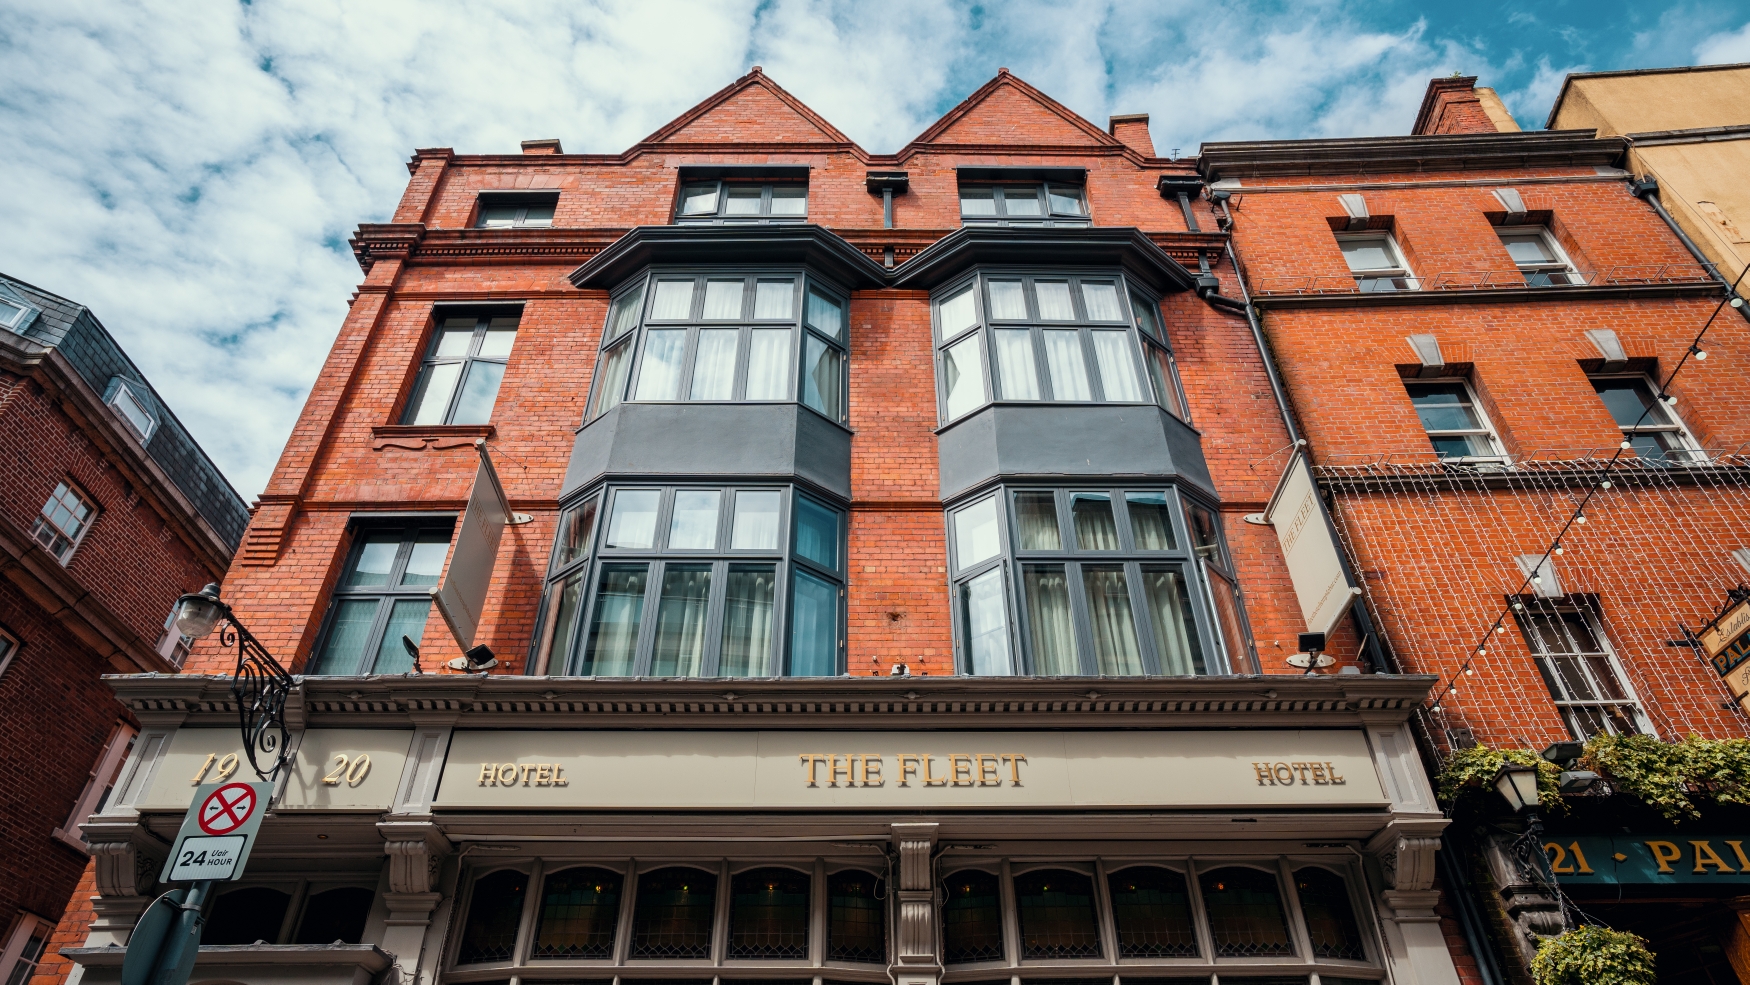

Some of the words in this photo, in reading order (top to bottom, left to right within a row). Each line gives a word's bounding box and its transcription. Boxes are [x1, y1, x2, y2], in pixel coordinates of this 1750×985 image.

[1283, 527, 1297, 552] THE
[1294, 492, 1314, 532] FLEET
[1714, 631, 1750, 675] PAL
[189, 752, 239, 782] 19
[321, 753, 370, 783] 20
[477, 763, 568, 783] HOTEL
[799, 753, 884, 783] THE
[896, 753, 1027, 783] FLEET
[1251, 761, 1344, 782] HOTEL
[180, 850, 208, 867] 24
[207, 858, 233, 866] HOUR
[1543, 841, 1595, 873] 21
